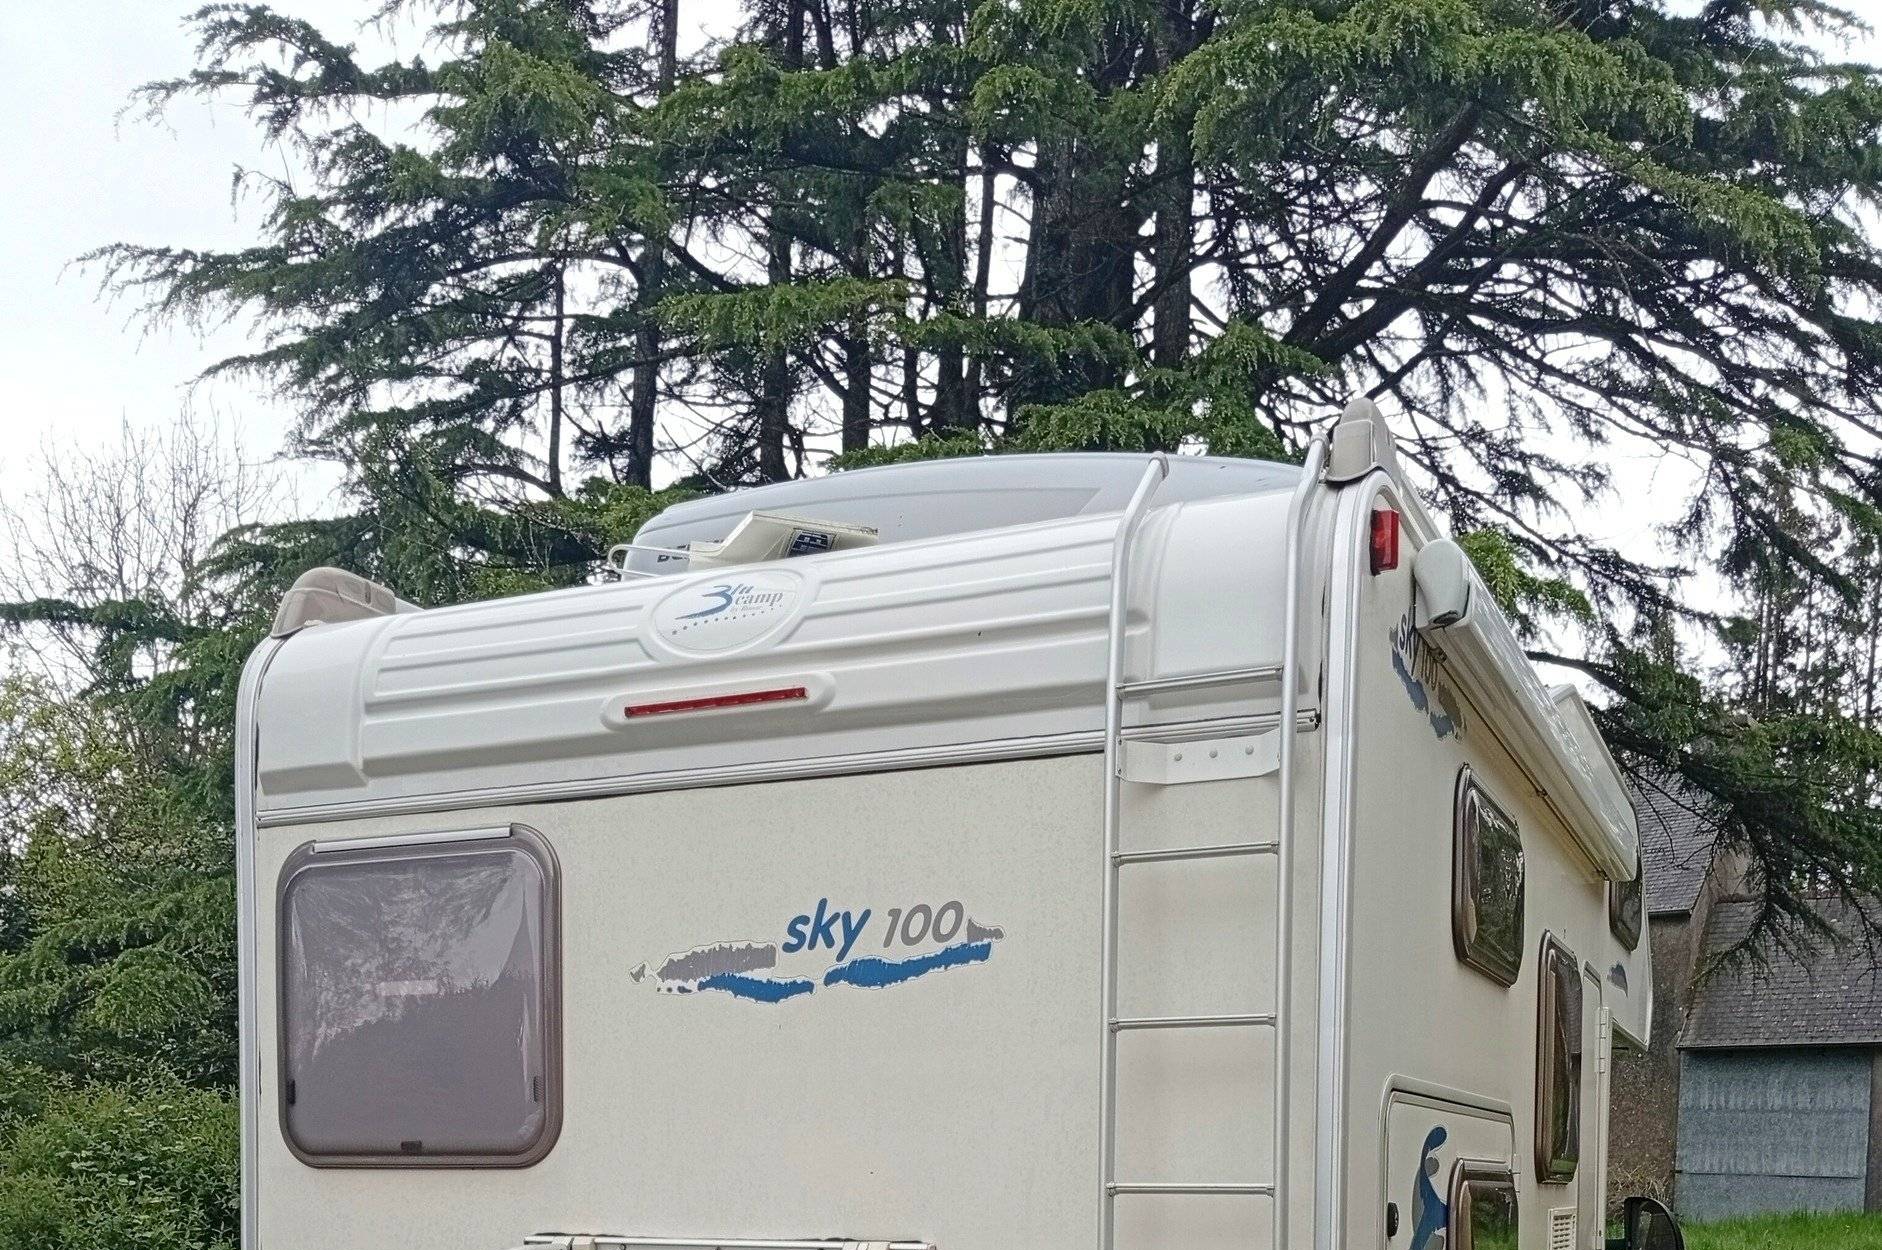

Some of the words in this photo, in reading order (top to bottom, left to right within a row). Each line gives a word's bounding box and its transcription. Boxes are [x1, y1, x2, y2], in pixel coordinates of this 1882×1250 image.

[735, 592, 783, 607] camp
[782, 898, 871, 963] sky
[882, 900, 964, 949] 100
